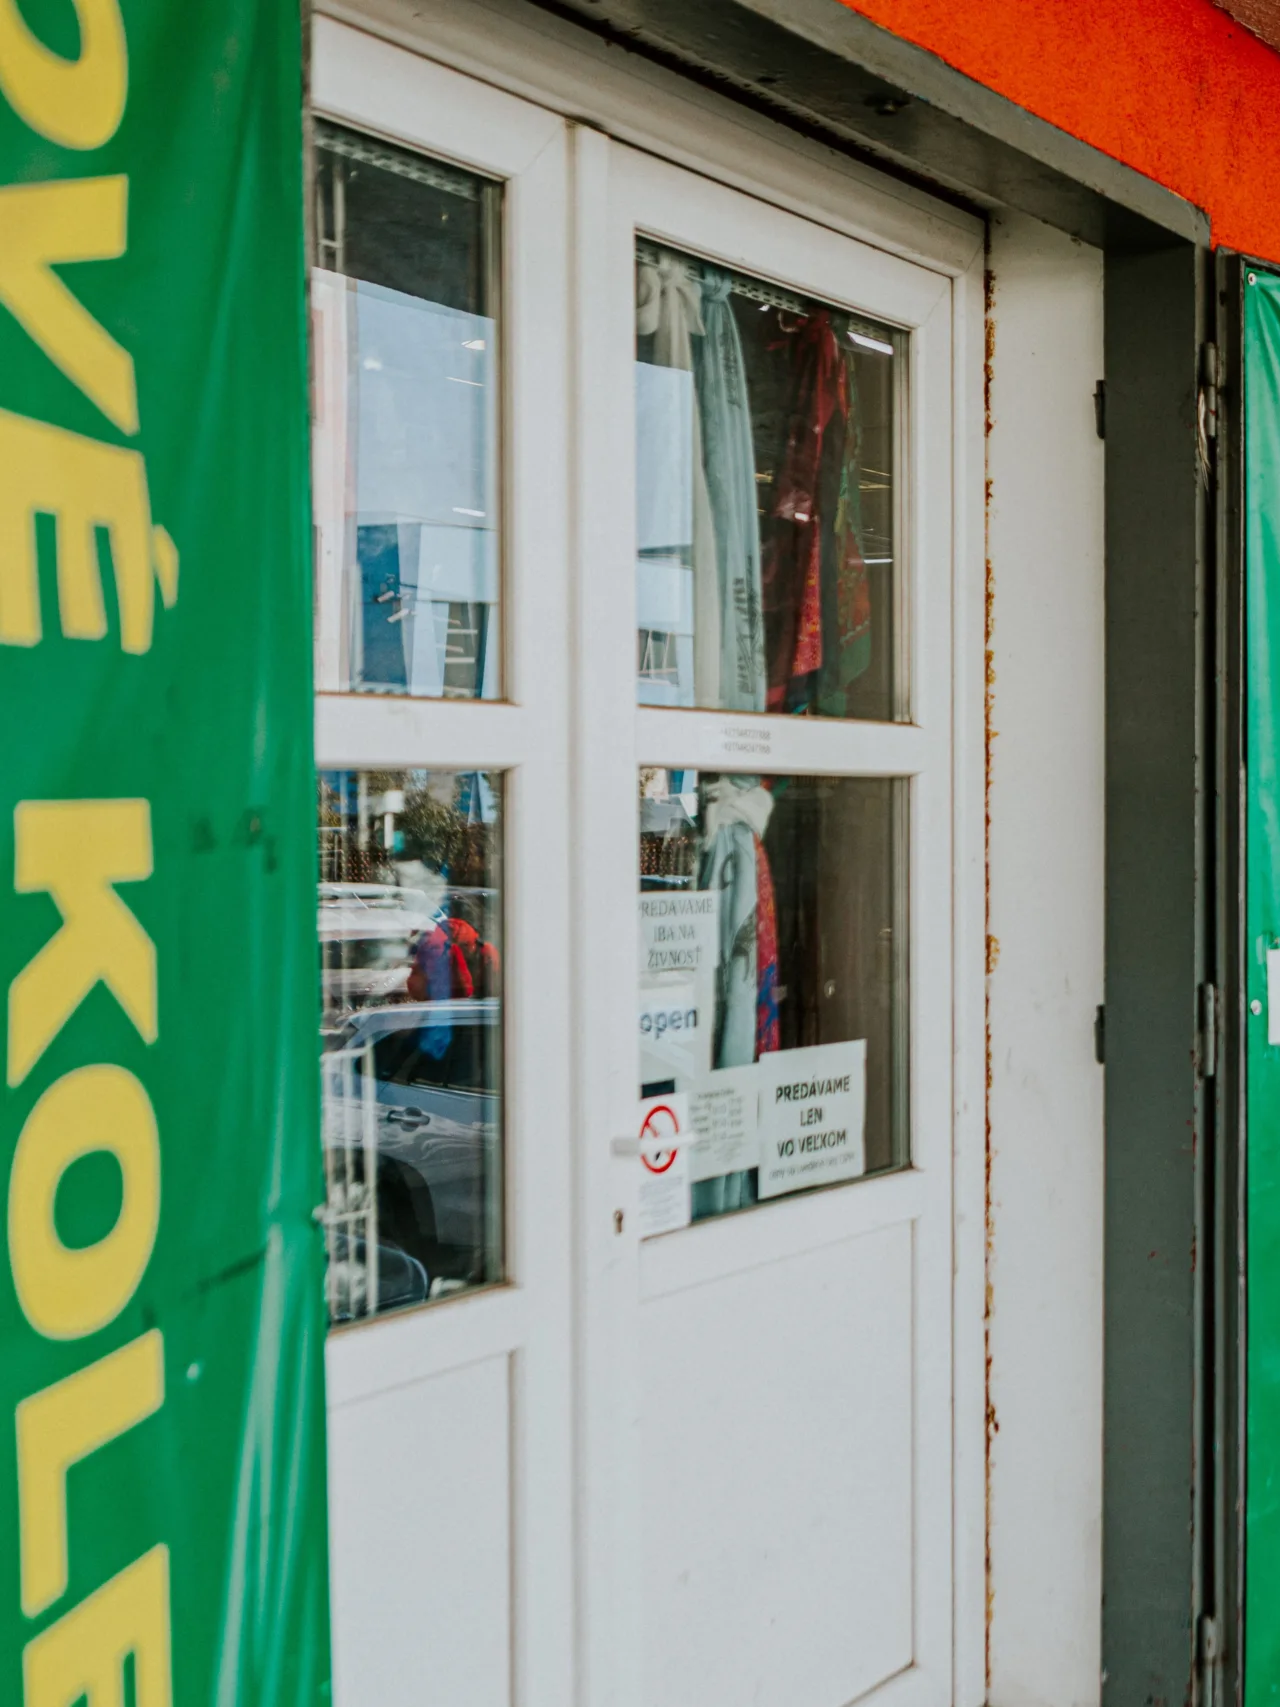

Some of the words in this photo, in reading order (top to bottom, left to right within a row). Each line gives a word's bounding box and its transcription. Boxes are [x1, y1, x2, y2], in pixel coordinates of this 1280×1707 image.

[678, 923, 696, 941] NA
[640, 1008, 698, 1039] open
[775, 1071, 852, 1104] PREDÁVAME
[800, 1107, 824, 1127] LEN
[777, 1138, 795, 1159] VO
